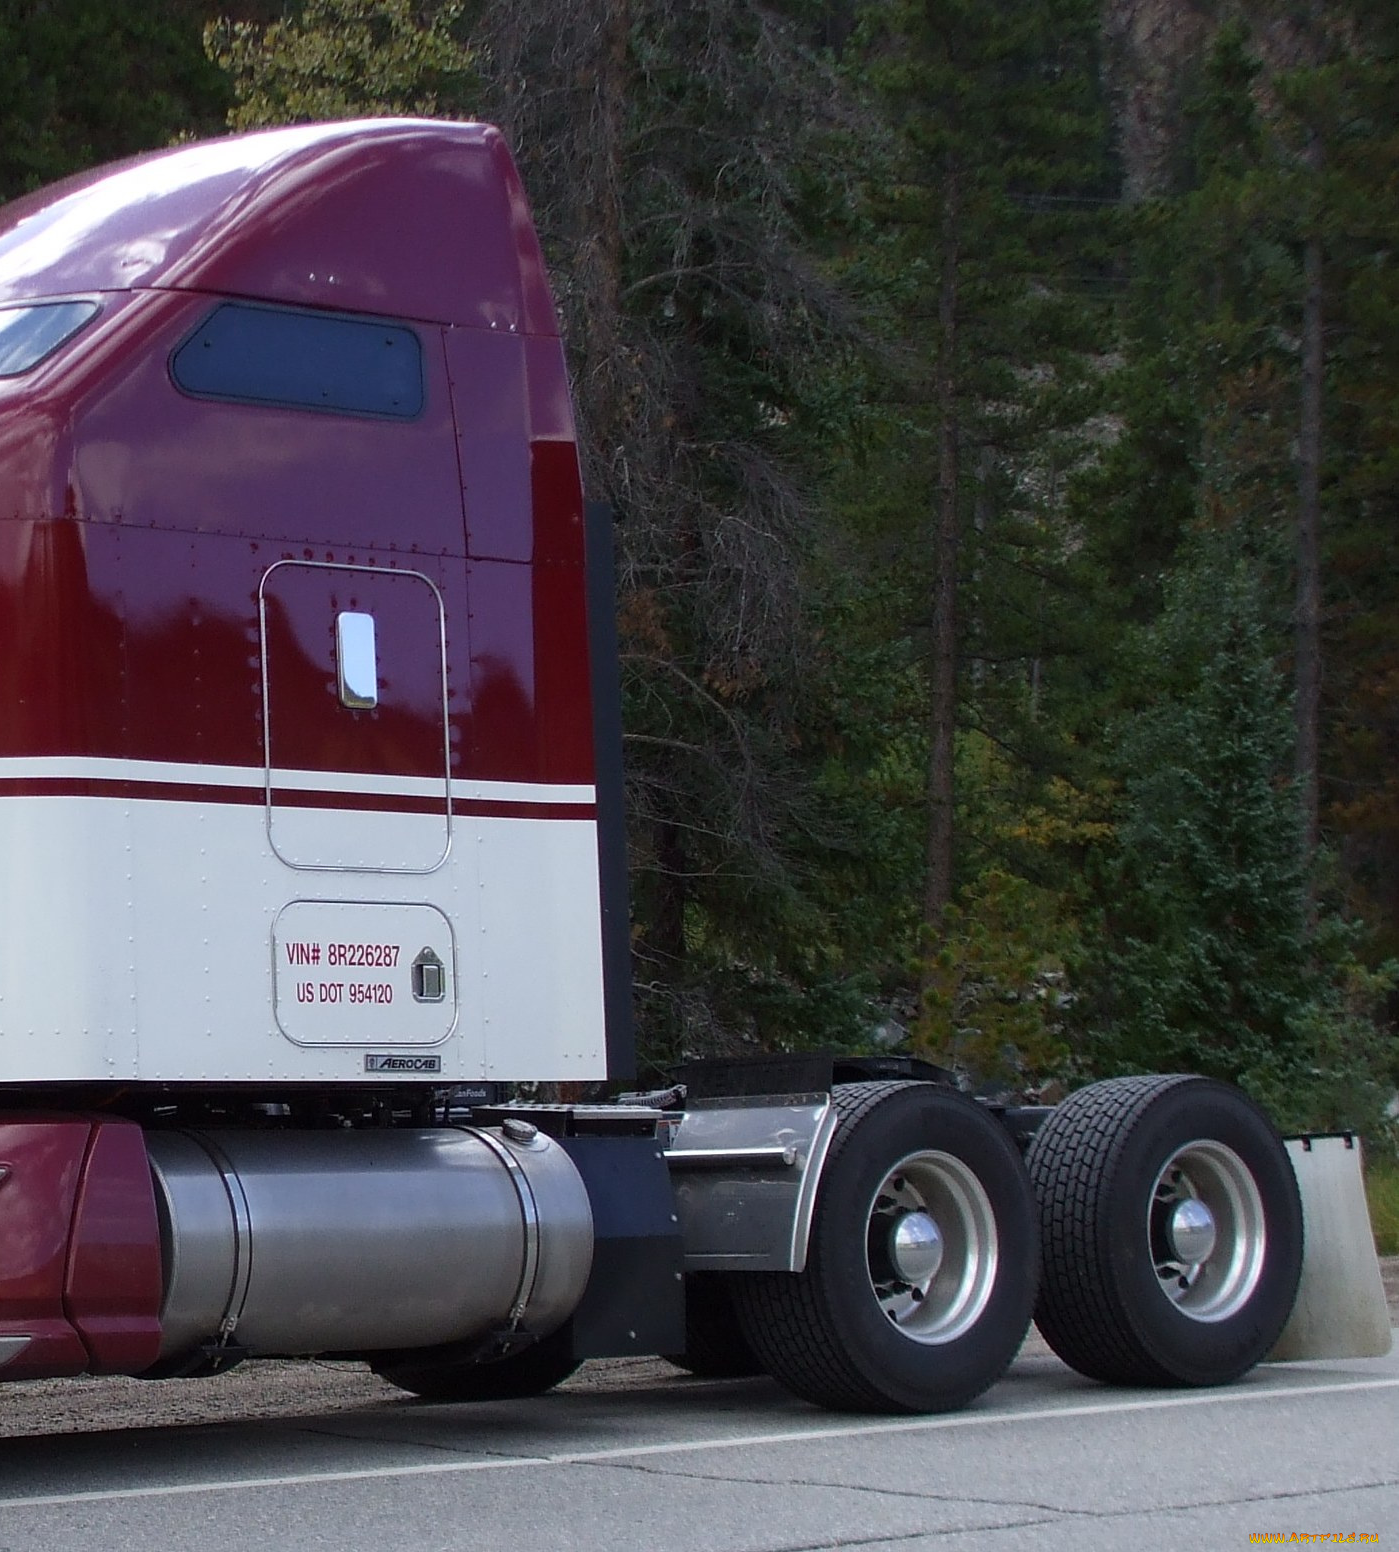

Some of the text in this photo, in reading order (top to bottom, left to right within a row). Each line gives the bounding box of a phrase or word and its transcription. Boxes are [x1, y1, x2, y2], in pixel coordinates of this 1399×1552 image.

[286, 943, 400, 967] VIN# 8R226287
[297, 983, 393, 1003] US DOT 954120
